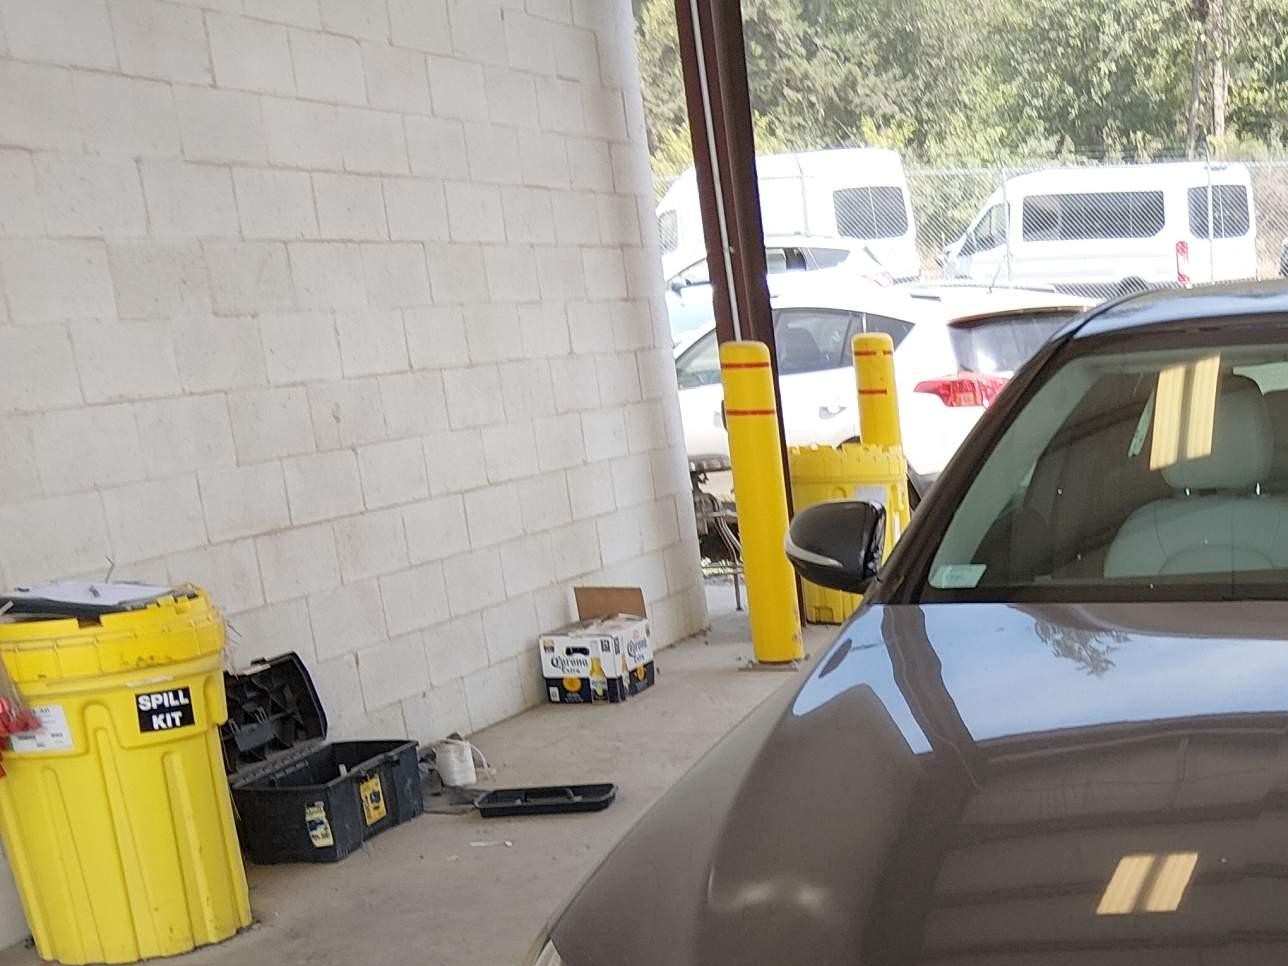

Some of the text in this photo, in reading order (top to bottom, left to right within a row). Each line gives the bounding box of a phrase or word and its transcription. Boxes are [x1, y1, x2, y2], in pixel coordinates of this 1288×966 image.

[551, 655, 588, 670] Corona
[138, 690, 190, 711] SPILL
[152, 711, 183, 730] KIT
